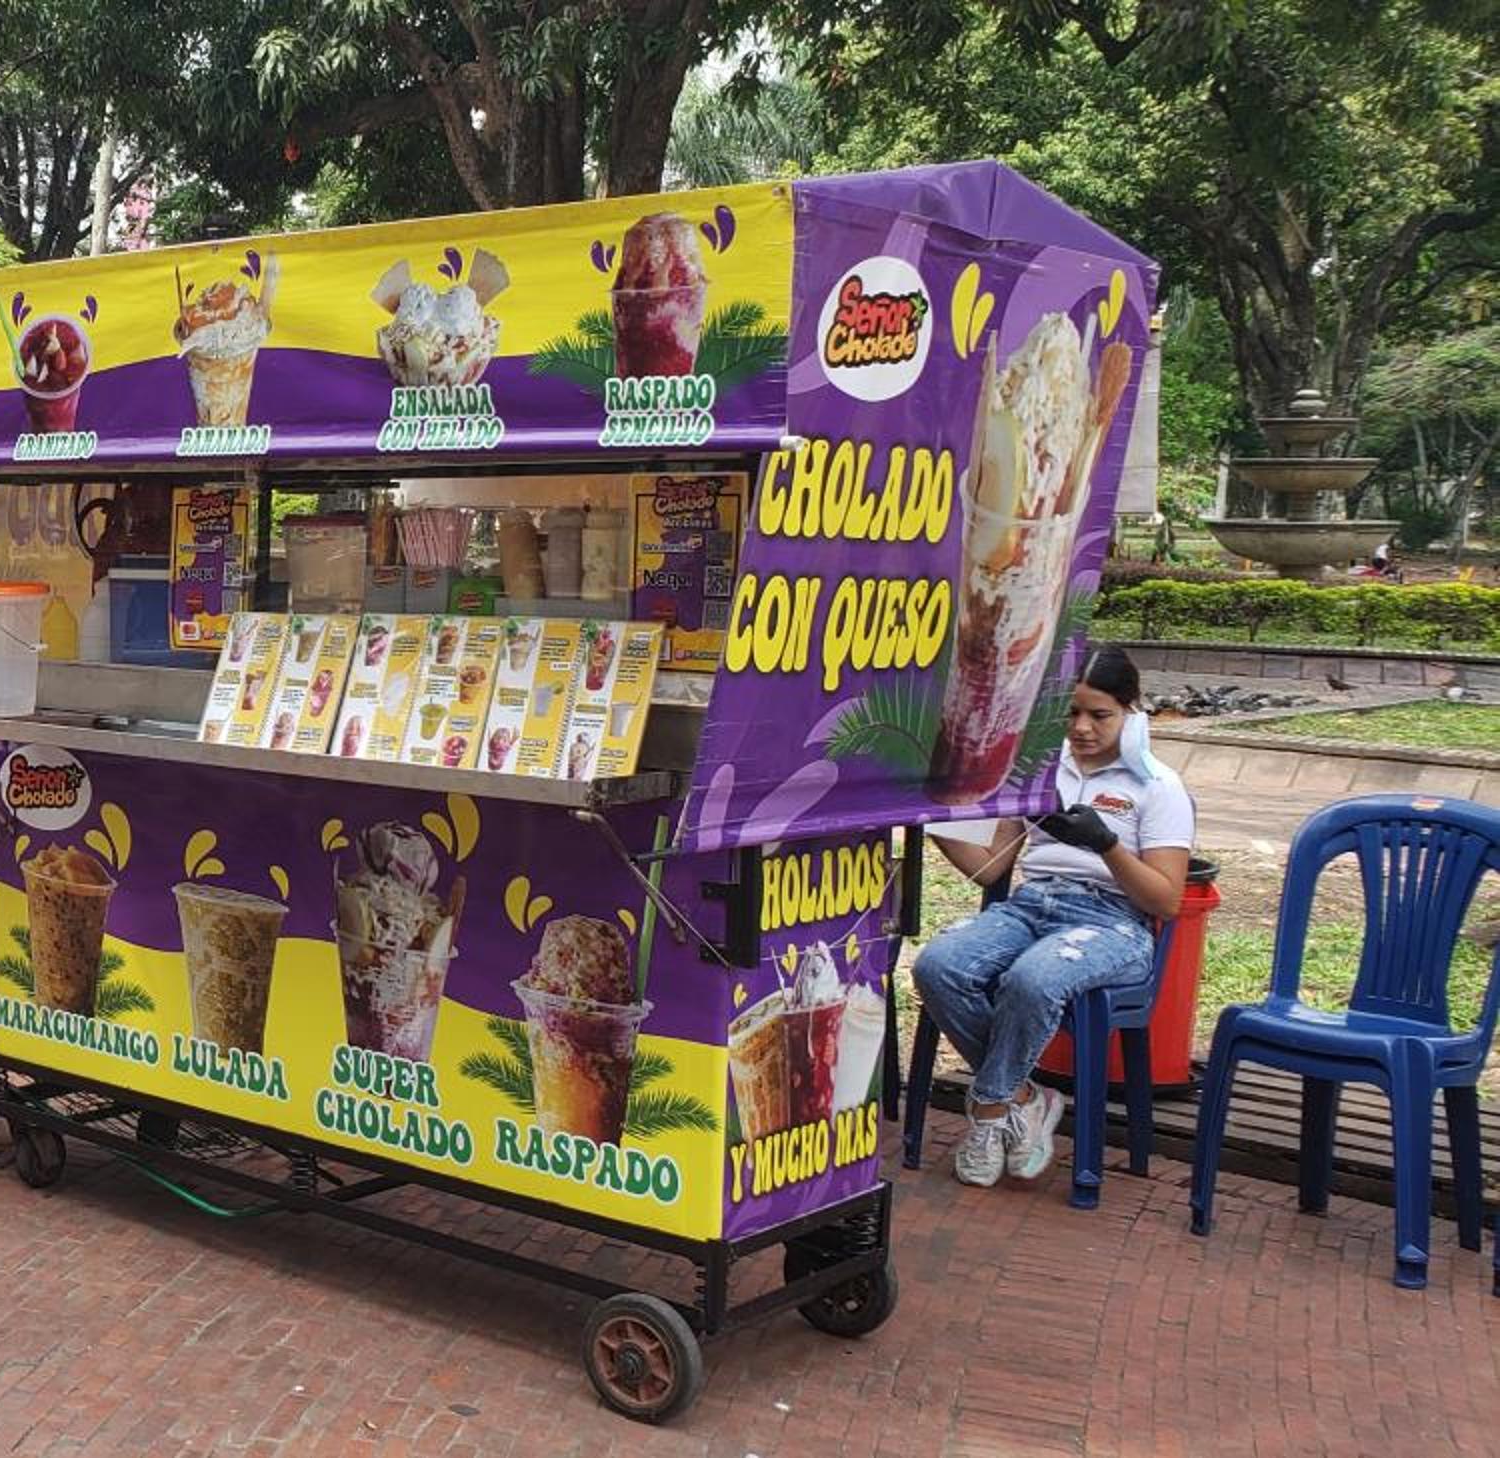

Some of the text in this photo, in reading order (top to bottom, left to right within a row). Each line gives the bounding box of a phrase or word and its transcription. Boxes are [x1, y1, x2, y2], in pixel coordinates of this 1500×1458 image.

[836, 276, 914, 334] Señor
[826, 320, 917, 367] Cholado
[391, 383, 495, 418] ENSALADA
[605, 374, 715, 411] RASPADO
[13, 431, 97, 461] GRANIZADO
[377, 417, 504, 450] CON HELADO
[599, 411, 714, 445] SENCILLO
[758, 439, 953, 544] CHOLADO
[725, 574, 821, 673] CON
[822, 577, 951, 691] QUESO
[6, 783, 77, 808] Cholado
[760, 841, 887, 932] HOLADOS
[172, 1035, 291, 1101] LULADA
[332, 1045, 439, 1107] SUPER
[315, 1089, 474, 1165] CHOLADO
[730, 1100, 879, 1204] Y MUCHO MAS
[495, 1118, 681, 1205] RASPADO
